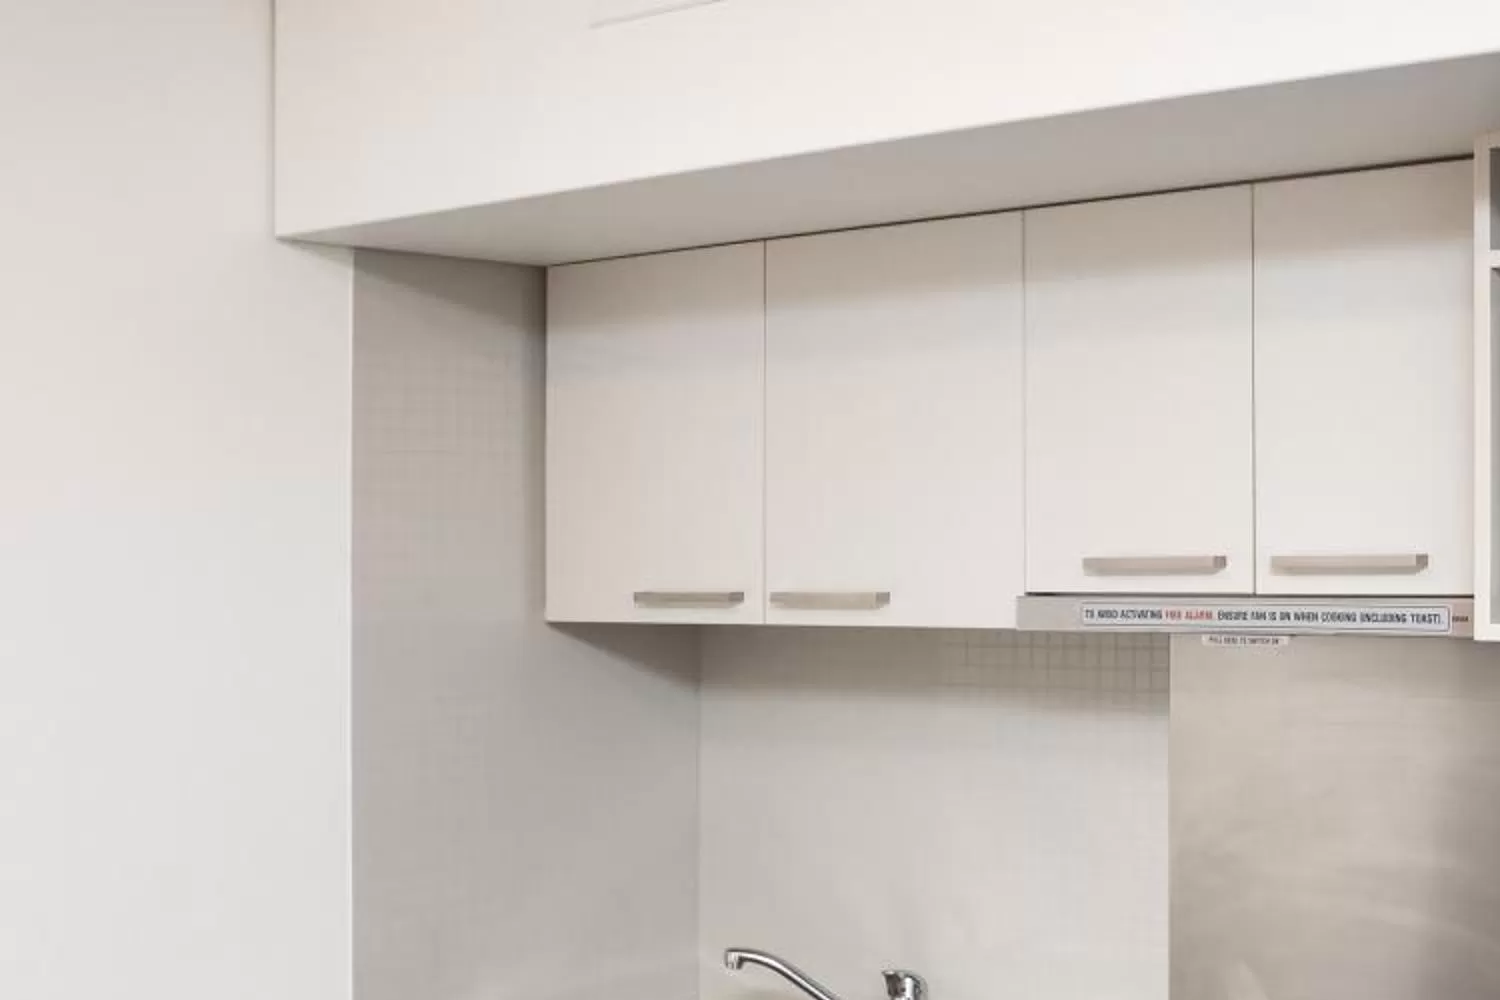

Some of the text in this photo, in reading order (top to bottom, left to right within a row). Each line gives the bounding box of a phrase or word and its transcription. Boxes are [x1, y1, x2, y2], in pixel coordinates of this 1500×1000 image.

[1120, 610, 1162, 620] ACTIVATING
[1218, 610, 1247, 621] ENSURE
[1294, 612, 1319, 622] WHEN
[1321, 612, 1356, 623] COOKING
